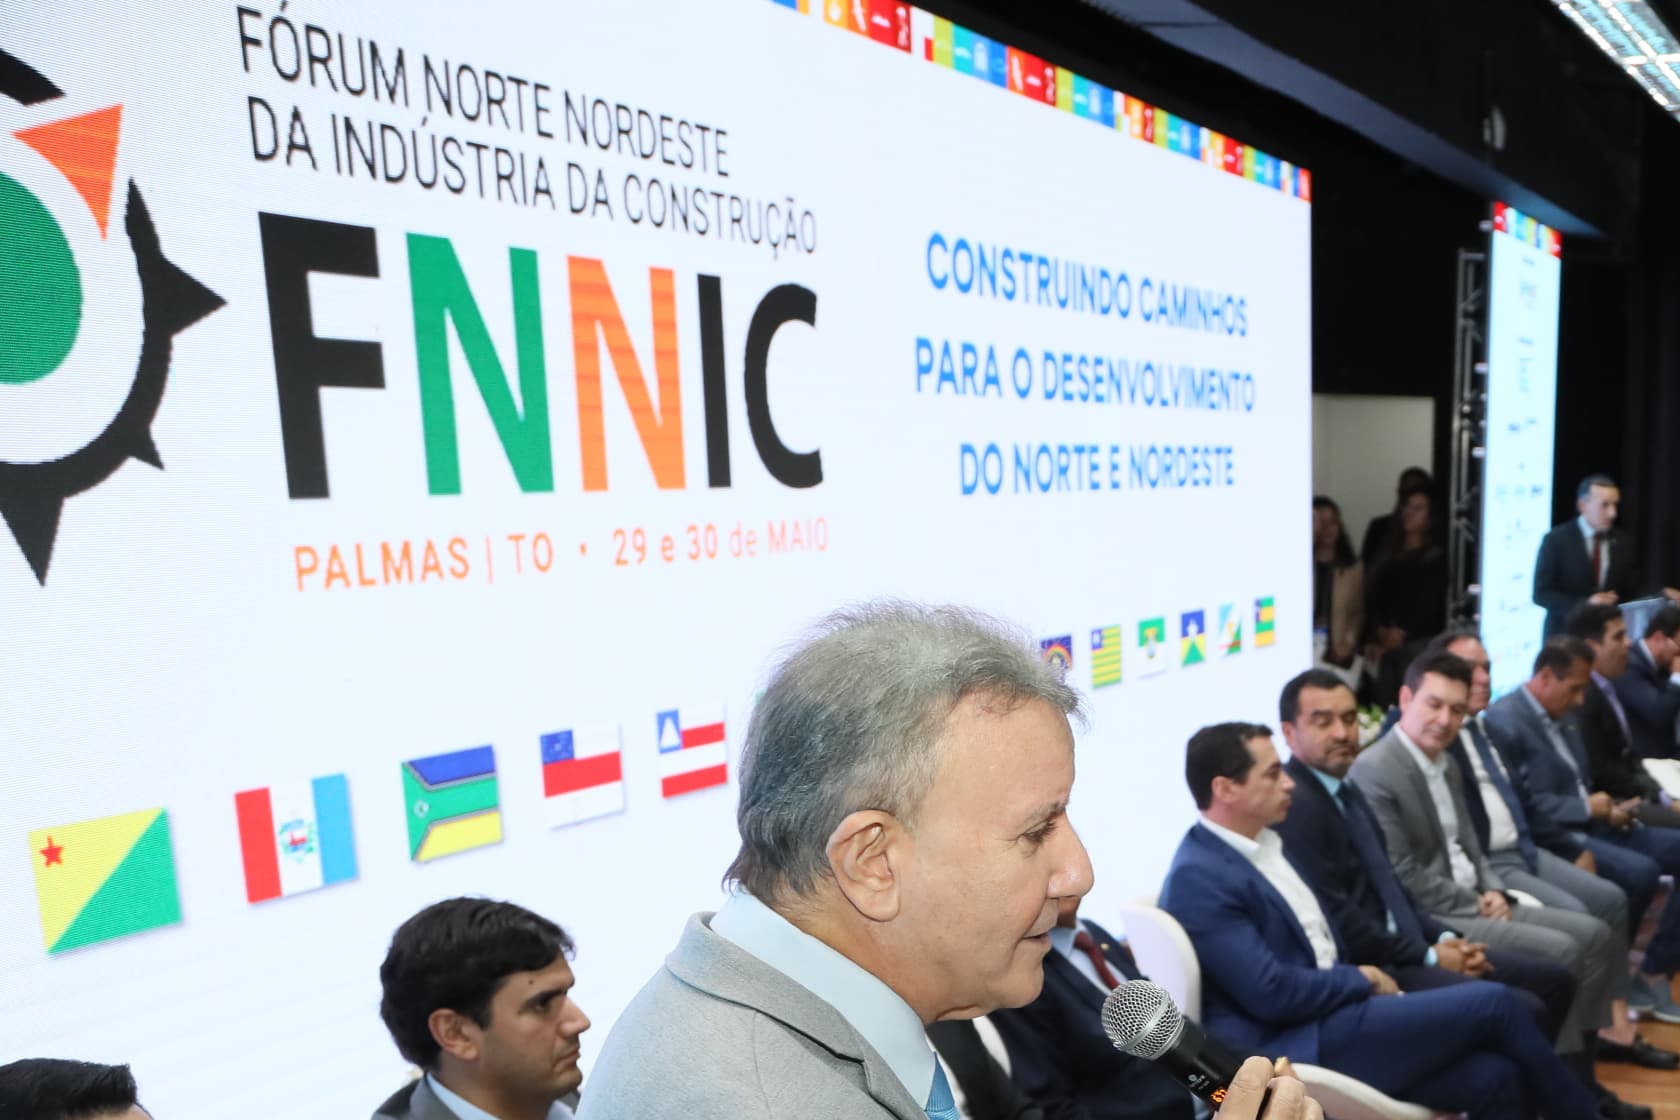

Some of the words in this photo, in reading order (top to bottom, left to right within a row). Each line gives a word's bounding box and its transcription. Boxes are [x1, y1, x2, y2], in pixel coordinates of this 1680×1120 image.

[235, 0, 410, 108] FÓRUM
[422, 54, 556, 140] NORTE
[563, 90, 732, 178] NORDESTE
[246, 96, 320, 172] DA
[330, 113, 557, 211] INDÚSTRIA
[567, 162, 615, 220] DA
[621, 172, 818, 260] CONSTRUÇÃO
[926, 231, 1132, 319] CONSTRUINDO
[1139, 275, 1250, 338] CAMINHOS
[256, 211, 825, 501] FNNIC
[915, 335, 1003, 398] PARA
[1012, 347, 1034, 401] O
[1043, 350, 1257, 413] DESENVOLVIMENTO
[960, 442, 1004, 497] DO
[1013, 443, 1102, 494] NORTE
[1109, 443, 1122, 492] E
[1128, 443, 1236, 490] NORDESTE
[293, 534, 472, 592] PALMAS
[507, 532, 556, 575] TO
[612, 527, 649, 568] 29
[659, 533, 677, 563] e
[686, 523, 720, 562] 30
[728, 520, 759, 559] de
[766, 516, 830, 554] MAIO
